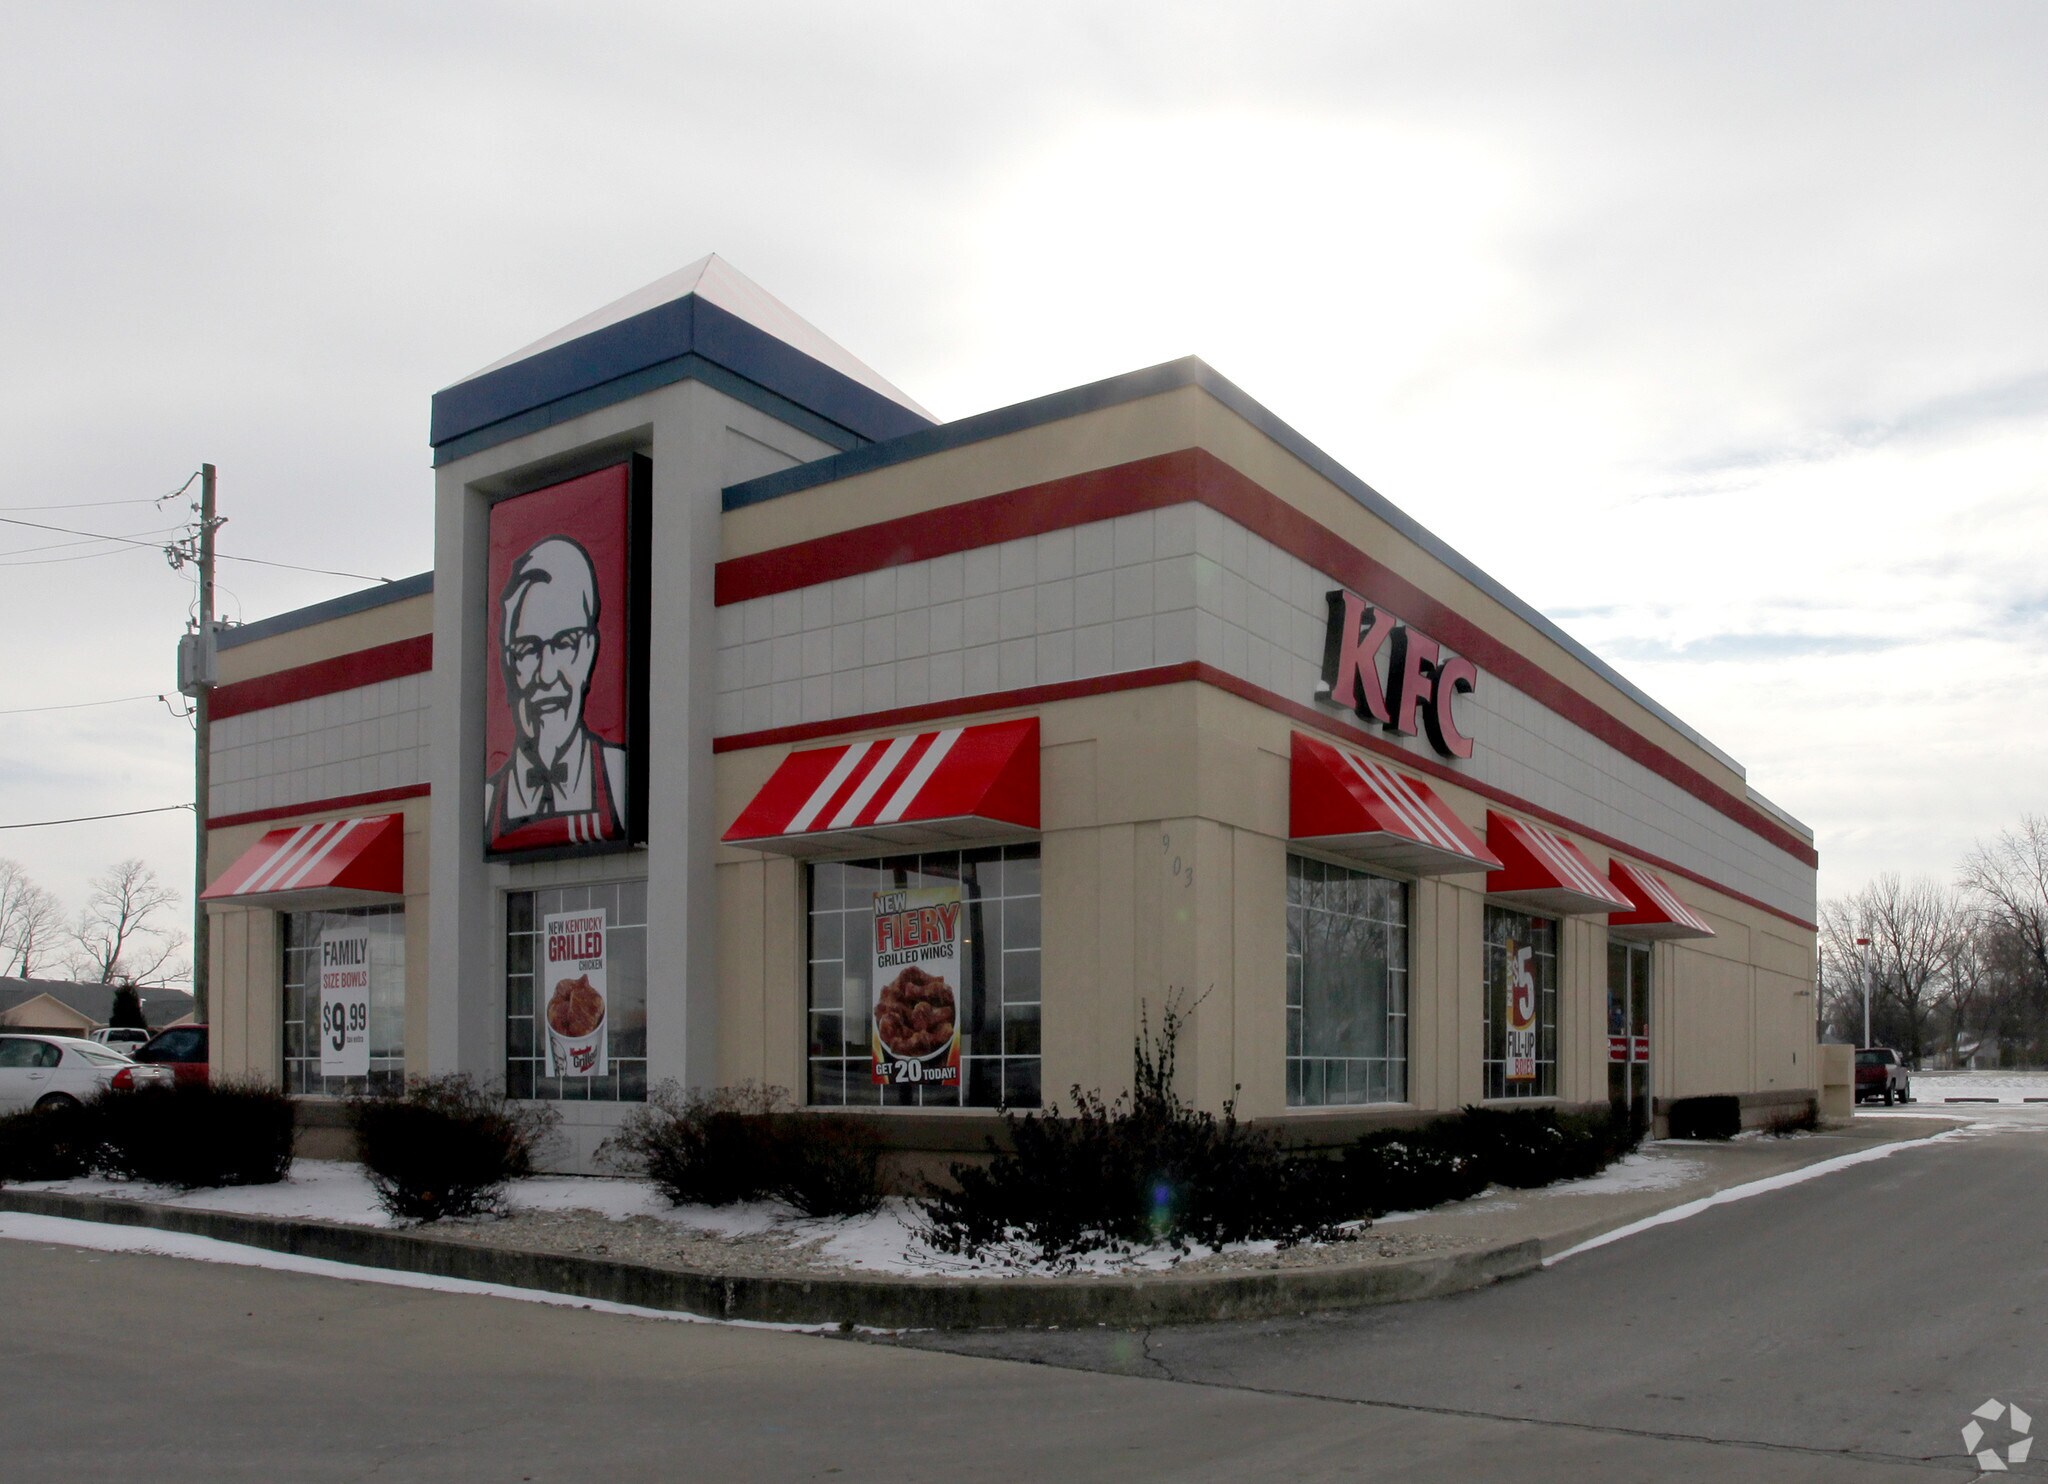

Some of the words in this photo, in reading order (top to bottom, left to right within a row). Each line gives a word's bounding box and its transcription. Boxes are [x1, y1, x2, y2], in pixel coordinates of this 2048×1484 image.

[1318, 588, 1478, 760] KFC
[1162, 833, 1193, 889] 903
[874, 892, 906, 914] NEW
[548, 921, 564, 935] NEW
[565, 917, 602, 932] KENTUCKY
[875, 902, 959, 951] FIERY
[323, 937, 368, 967] FAMILY
[549, 931, 602, 962] GRILLED
[878, 949, 918, 968] GRILLED
[921, 944, 953, 961] WINGS
[579, 958, 602, 971] CHICKEN
[323, 973, 340, 989] SIZE
[341, 970, 367, 988] BOWLS
[323, 1001, 367, 1052] $9.99
[1508, 1031, 1535, 1058] FILL-UP
[876, 1062, 893, 1077] GET
[895, 1059, 922, 1083] 20
[924, 1067, 956, 1080] TODAY!
